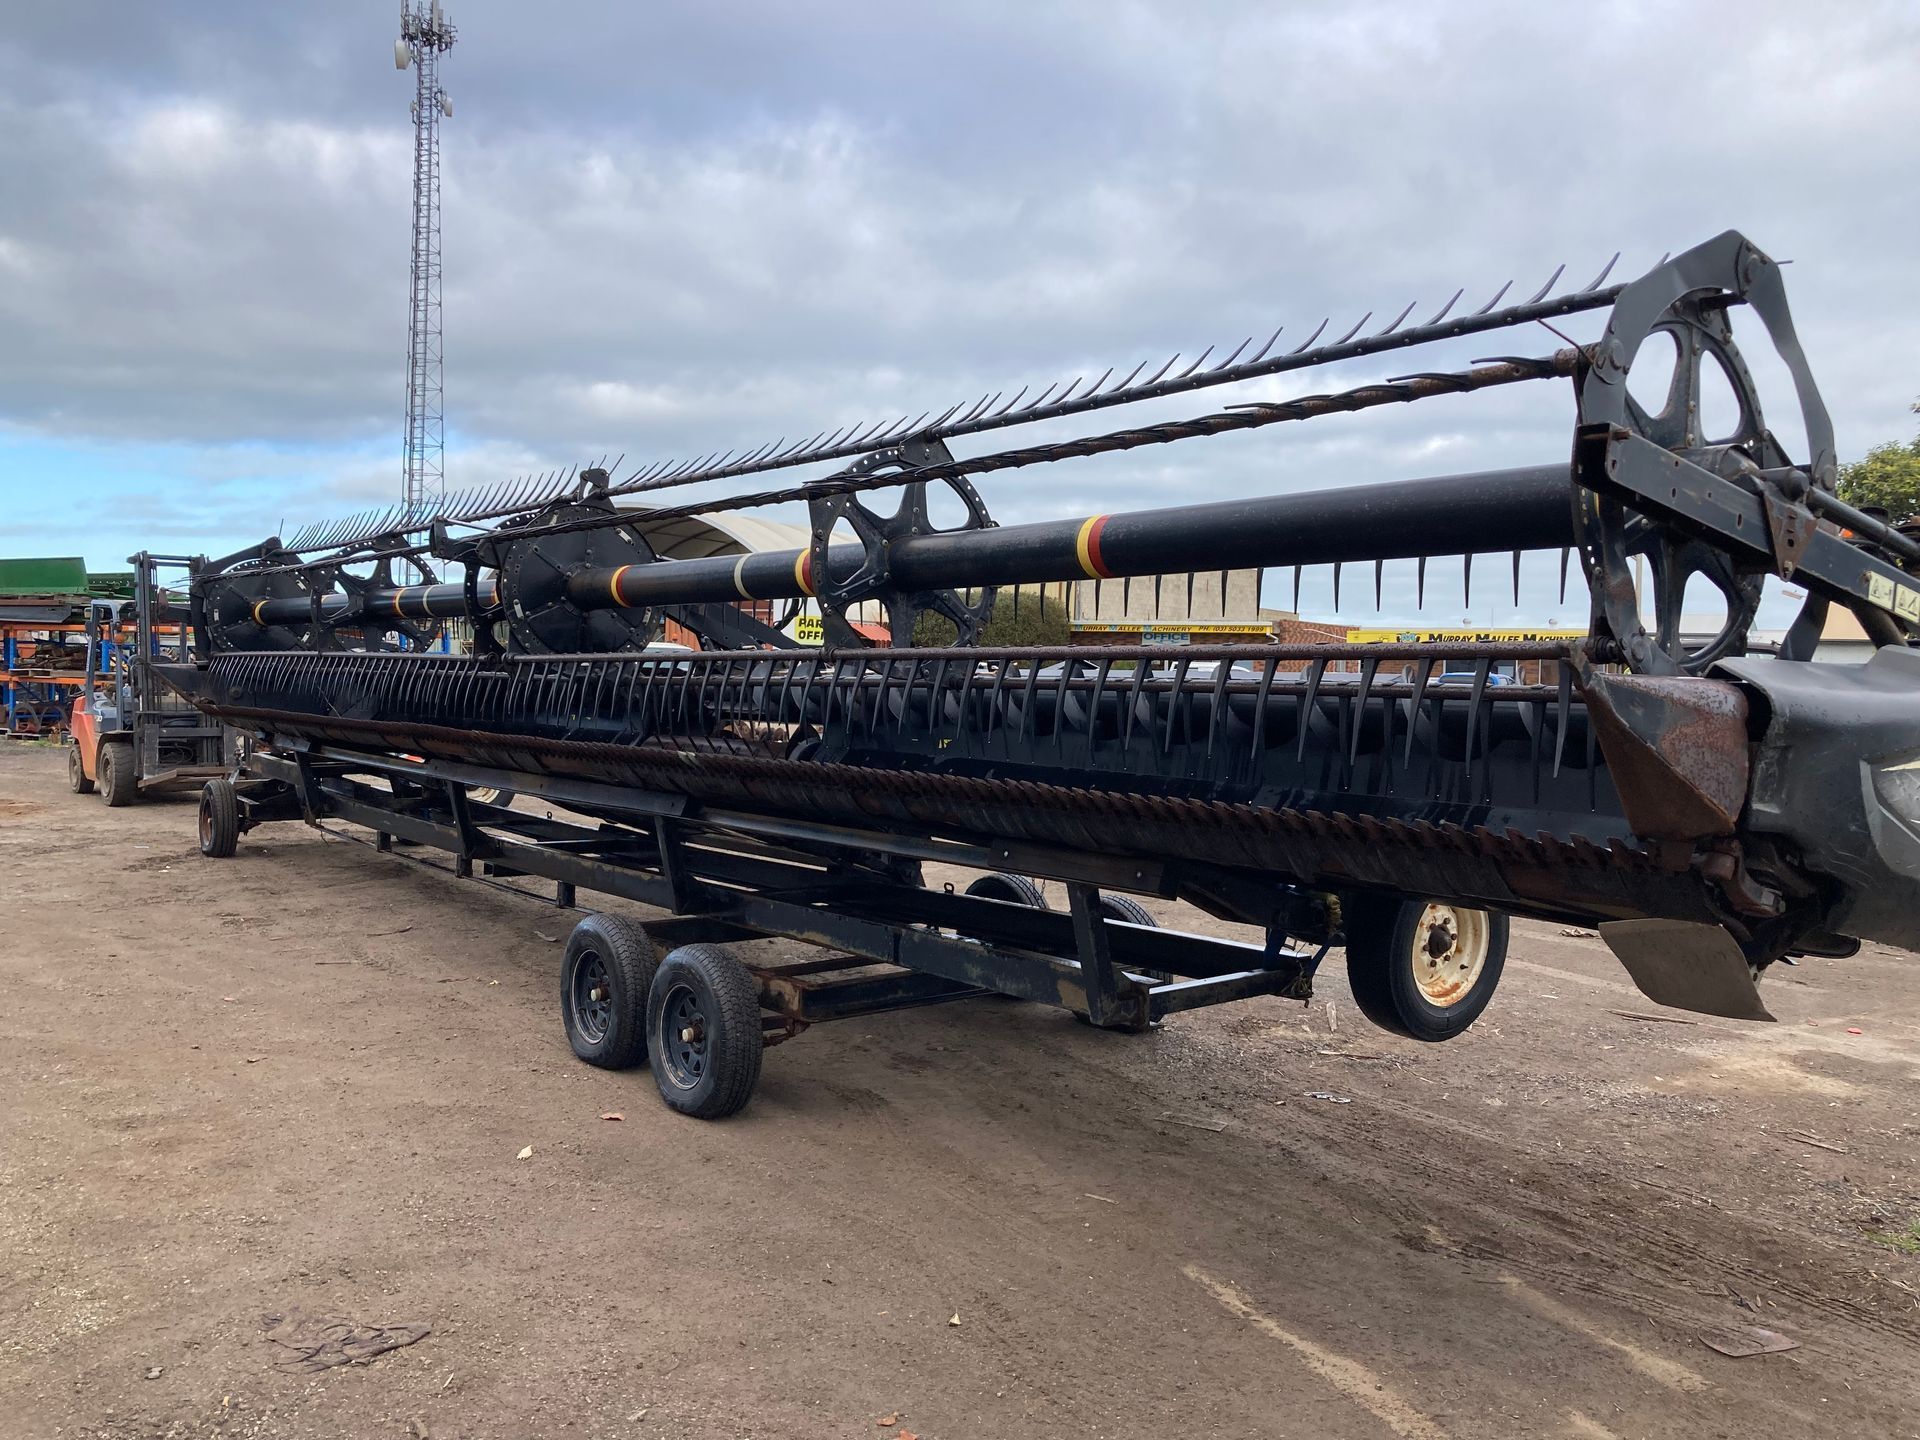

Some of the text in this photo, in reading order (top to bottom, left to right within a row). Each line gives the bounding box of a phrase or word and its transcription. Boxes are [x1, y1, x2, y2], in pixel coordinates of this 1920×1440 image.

[798, 618, 823, 628] PAR
[798, 630, 824, 640] OFFI
[1143, 632, 1188, 640] OFFICE
[1429, 633, 1581, 642] MURRAY MALLEE MACHI
